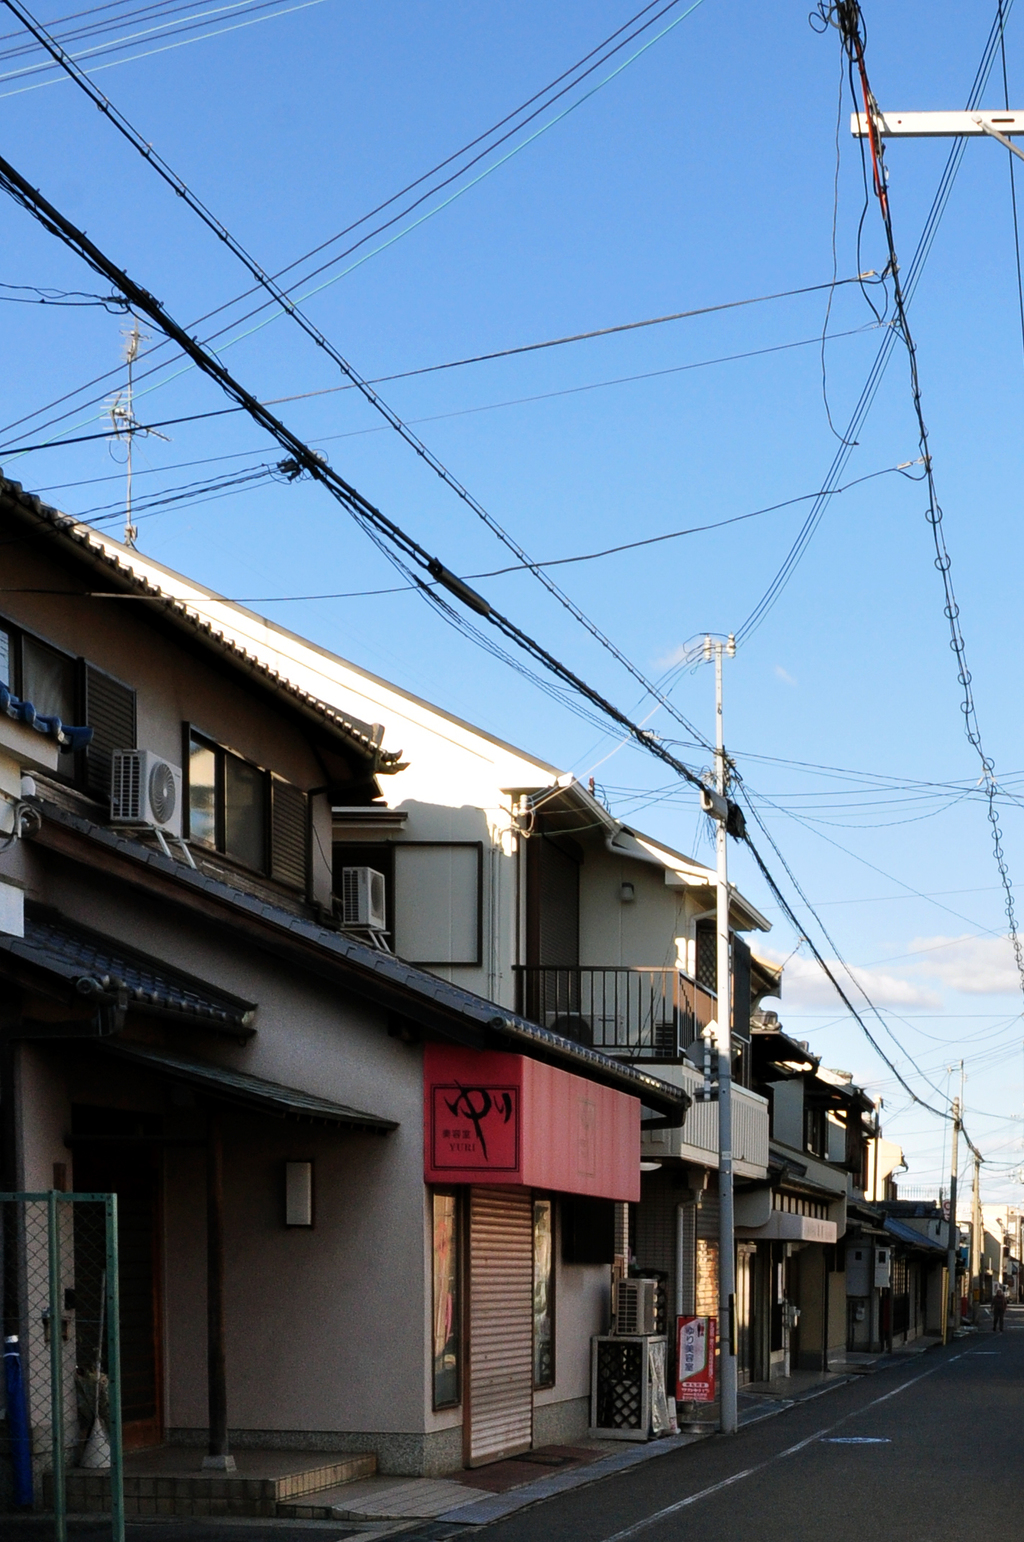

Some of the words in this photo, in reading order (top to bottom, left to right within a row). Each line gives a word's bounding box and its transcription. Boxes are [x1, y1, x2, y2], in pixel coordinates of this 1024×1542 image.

[444, 1079, 512, 1161] ゆり
[442, 1129, 471, 1139] 美容室
[449, 1142, 476, 1152] YURI
[685, 1326, 694, 1371] ゆり美容室
